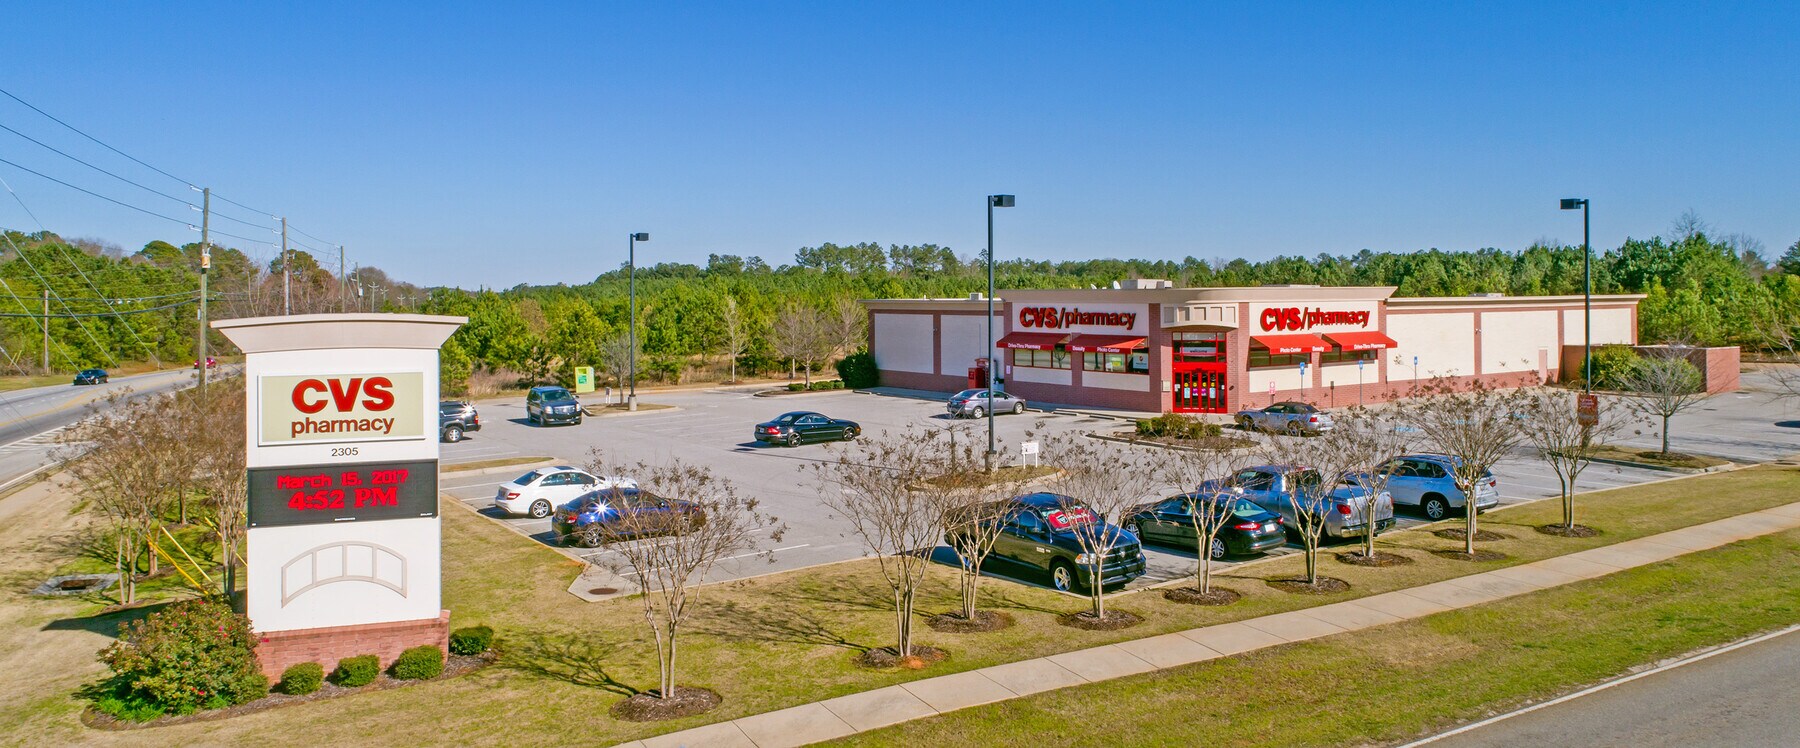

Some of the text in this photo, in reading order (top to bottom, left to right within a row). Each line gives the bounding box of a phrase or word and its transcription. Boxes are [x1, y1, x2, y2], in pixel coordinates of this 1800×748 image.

[1019, 306, 1136, 330] CVS/pharmacy
[1260, 306, 1370, 332] CVS/pharmacy
[291, 376, 395, 414] CVS
[291, 417, 395, 438] pharmacy
[331, 447, 359, 457] 2305
[277, 473, 332, 489] March
[371, 469, 409, 485] 2017
[288, 487, 398, 511] 4:52 PM
